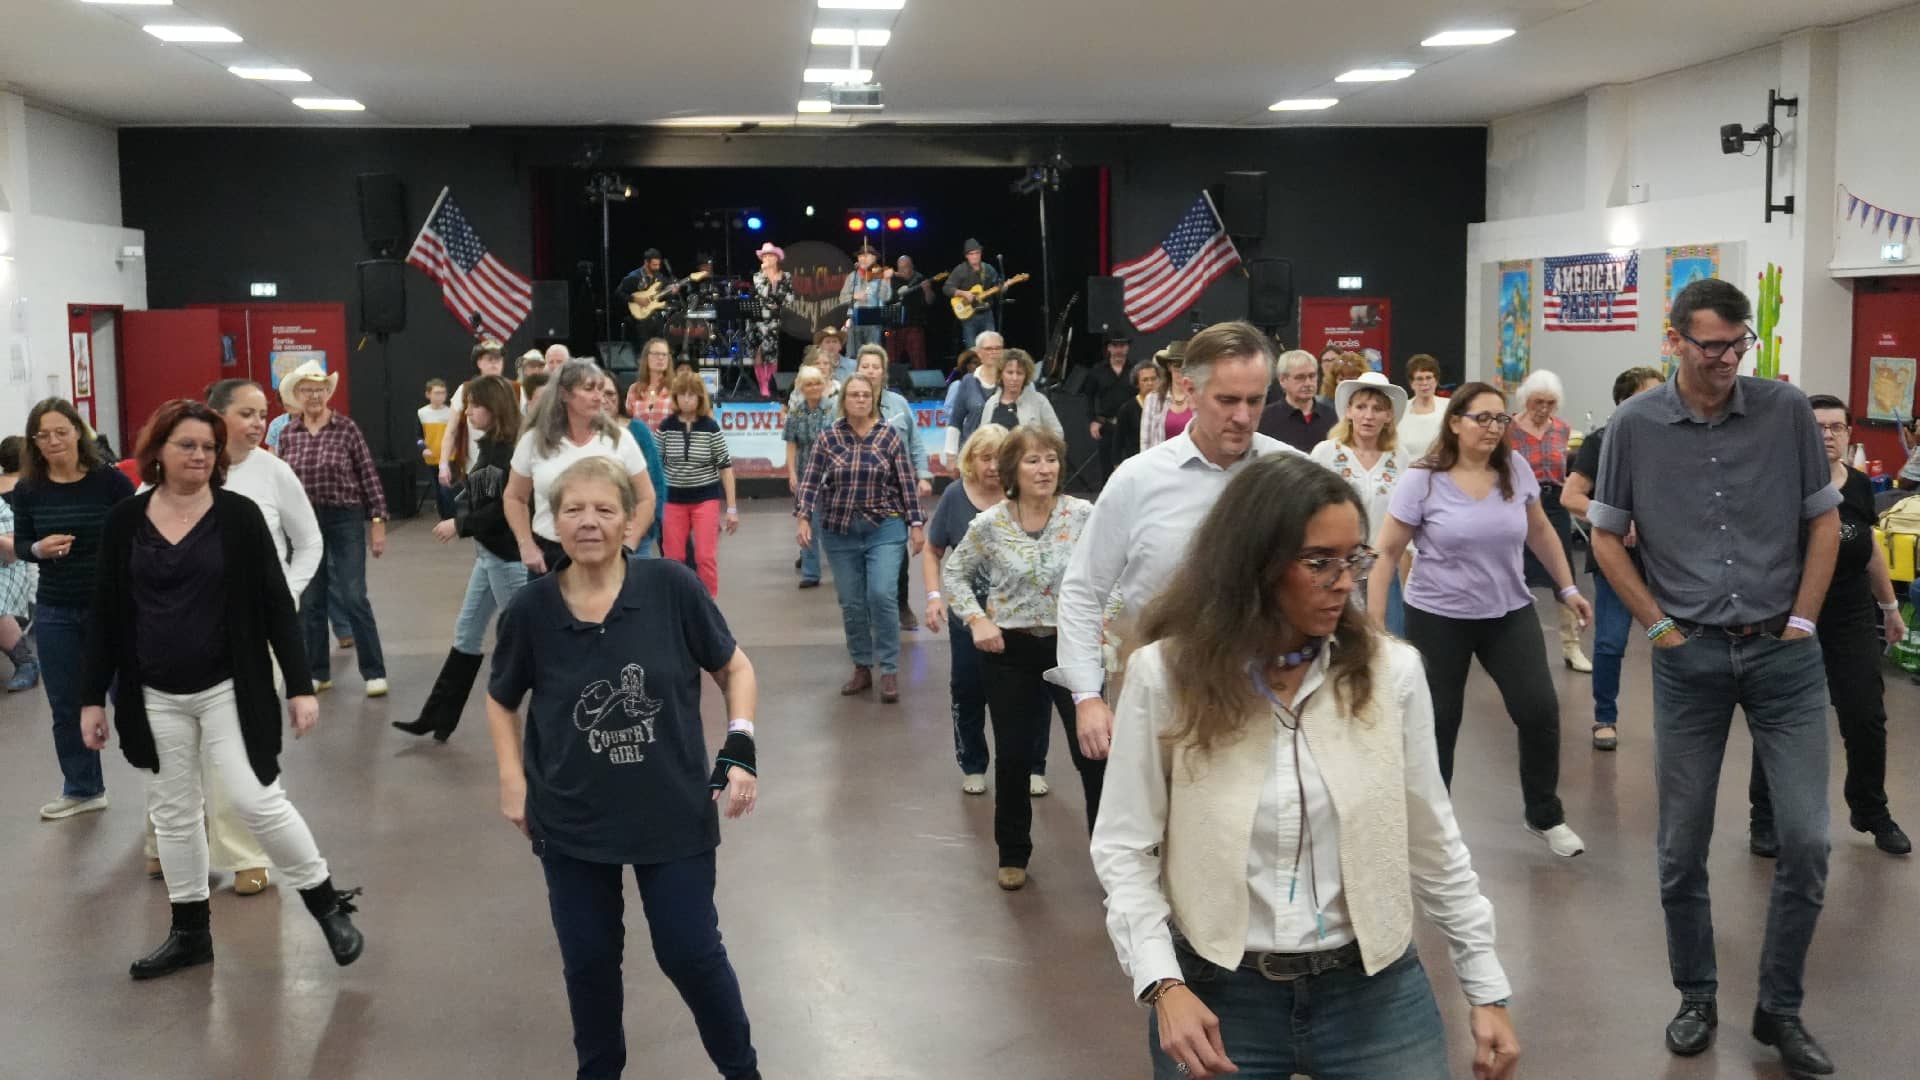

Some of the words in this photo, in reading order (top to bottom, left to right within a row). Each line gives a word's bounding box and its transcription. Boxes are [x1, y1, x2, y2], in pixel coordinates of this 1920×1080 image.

[1553, 262, 1626, 296] AMERICAN
[1559, 290, 1617, 323] PARTY
[588, 717, 656, 753] COUNTRY
[609, 744, 645, 764] GIRL
